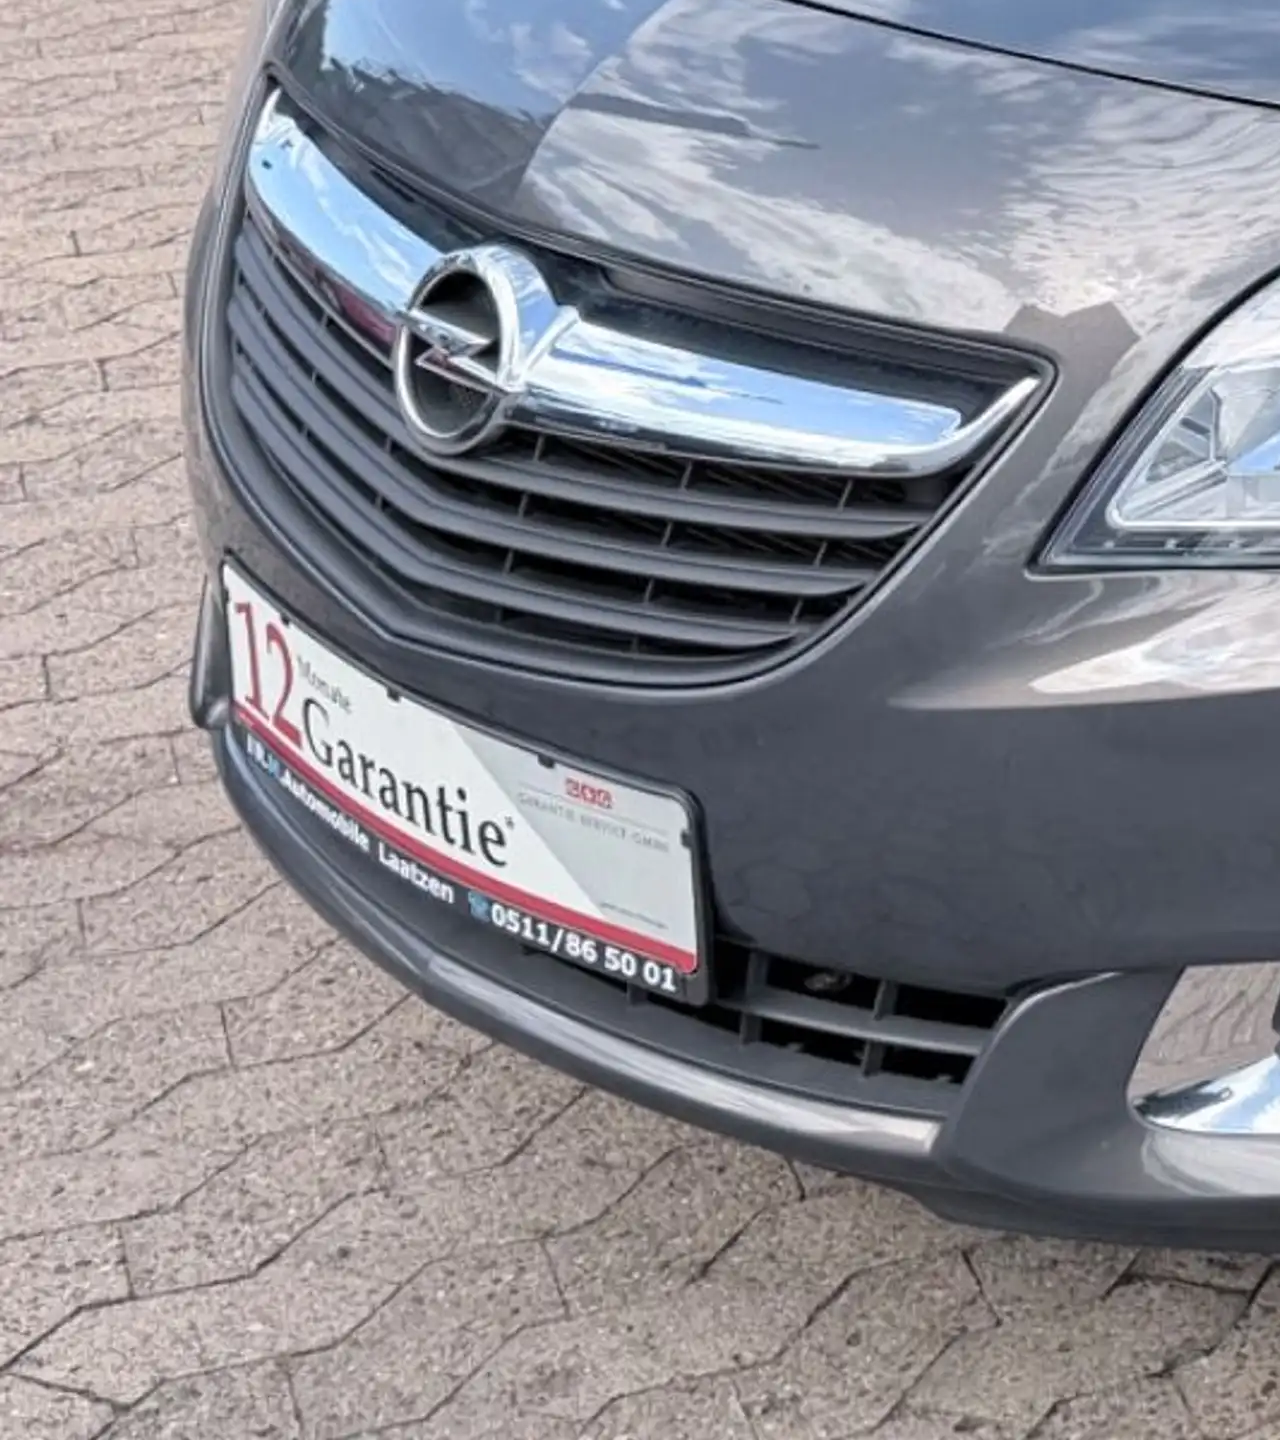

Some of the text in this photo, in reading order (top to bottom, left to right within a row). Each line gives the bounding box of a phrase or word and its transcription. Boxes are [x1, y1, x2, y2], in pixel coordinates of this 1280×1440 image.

[234, 602, 304, 751] 12
[303, 696, 507, 867] Garantie
[279, 767, 371, 853] Automobile
[378, 840, 456, 905] Laatzen
[491, 902, 598, 965] 0511/86
[604, 946, 637, 977] 50
[643, 961, 677, 993] 01
